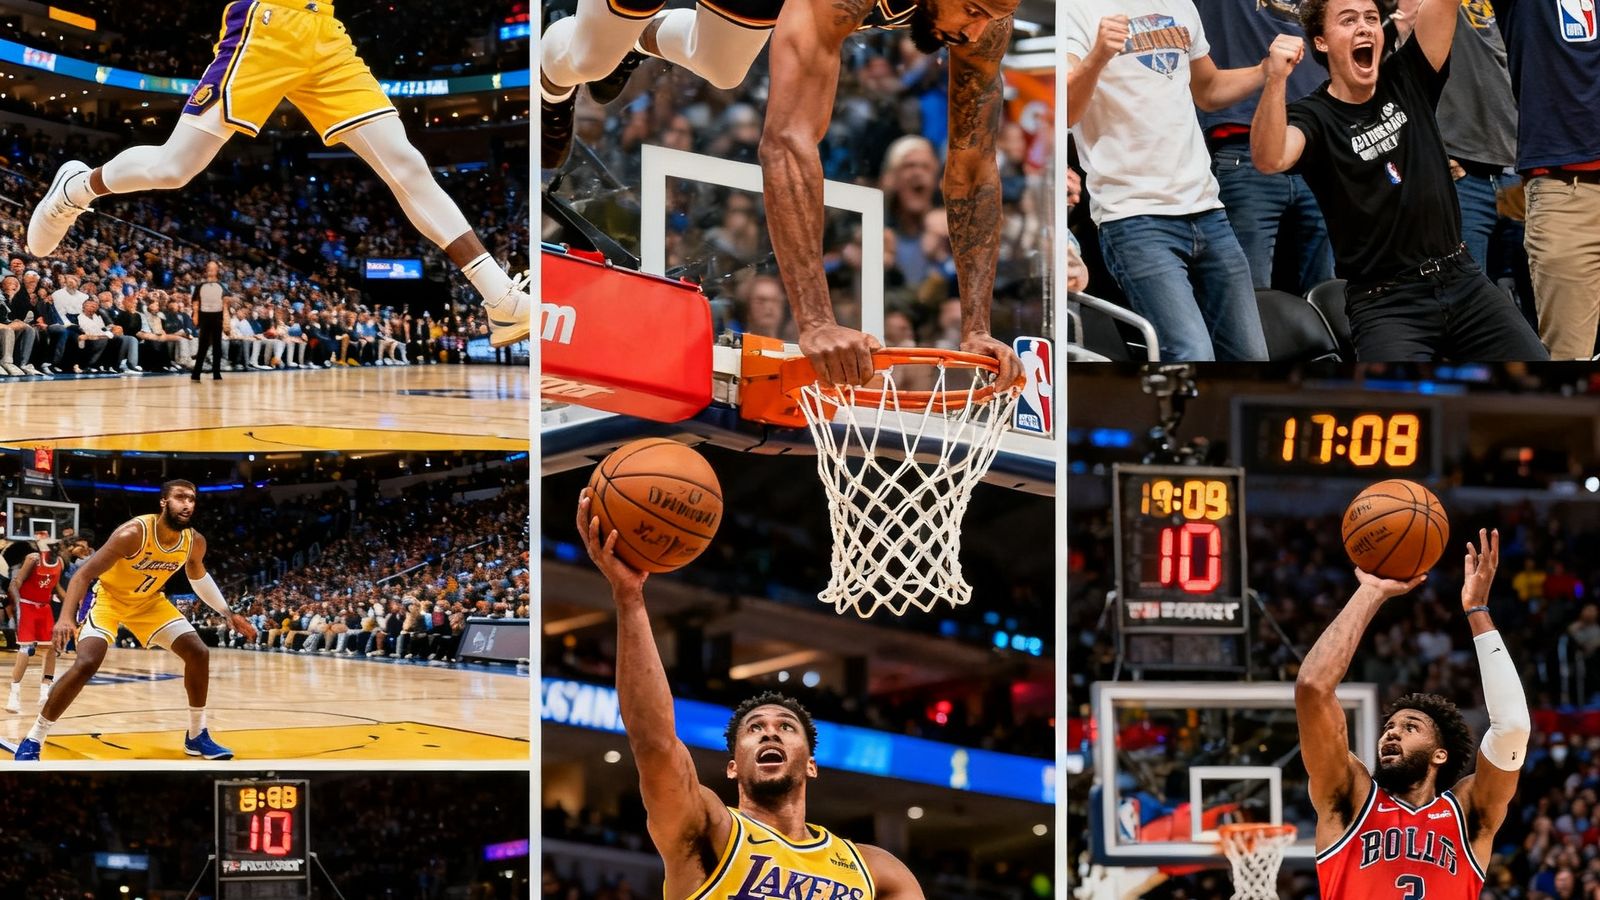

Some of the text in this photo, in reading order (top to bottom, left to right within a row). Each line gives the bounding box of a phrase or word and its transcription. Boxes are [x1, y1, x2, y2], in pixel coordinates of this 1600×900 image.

[1282, 414, 1420, 467] 17:08
[1160, 522, 1221, 592] 10
[250, 810, 291, 855] 10
